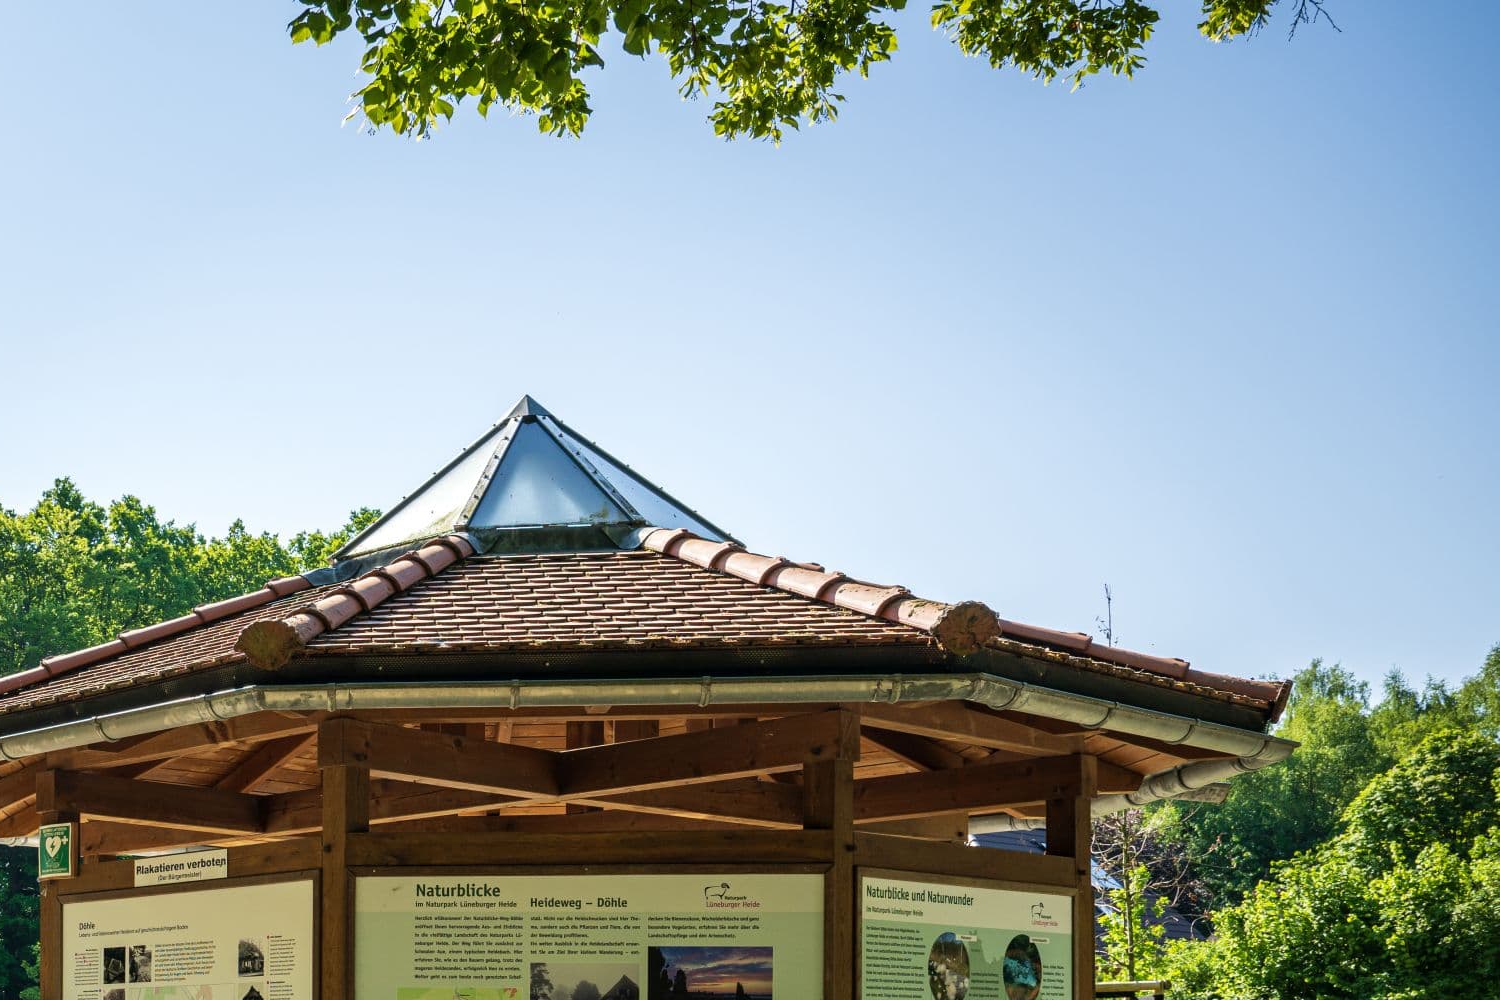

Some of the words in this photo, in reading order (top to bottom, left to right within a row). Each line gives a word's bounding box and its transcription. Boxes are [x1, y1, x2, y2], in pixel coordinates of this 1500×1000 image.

[136, 860, 185, 875] Plakatieren
[186, 857, 226, 871] verboten
[416, 883, 501, 897] Naturblicke
[866, 885, 909, 901] Naturblicke
[911, 890, 925, 902] und
[928, 891, 974, 906] Naturwunder
[425, 901, 458, 909] Naturpark
[460, 900, 497, 909] Lüneburger
[530, 897, 582, 910] Heideweg
[597, 897, 628, 908] Döhle
[706, 900, 741, 909] Lüneburger
[79, 922, 95, 931] Döhle
